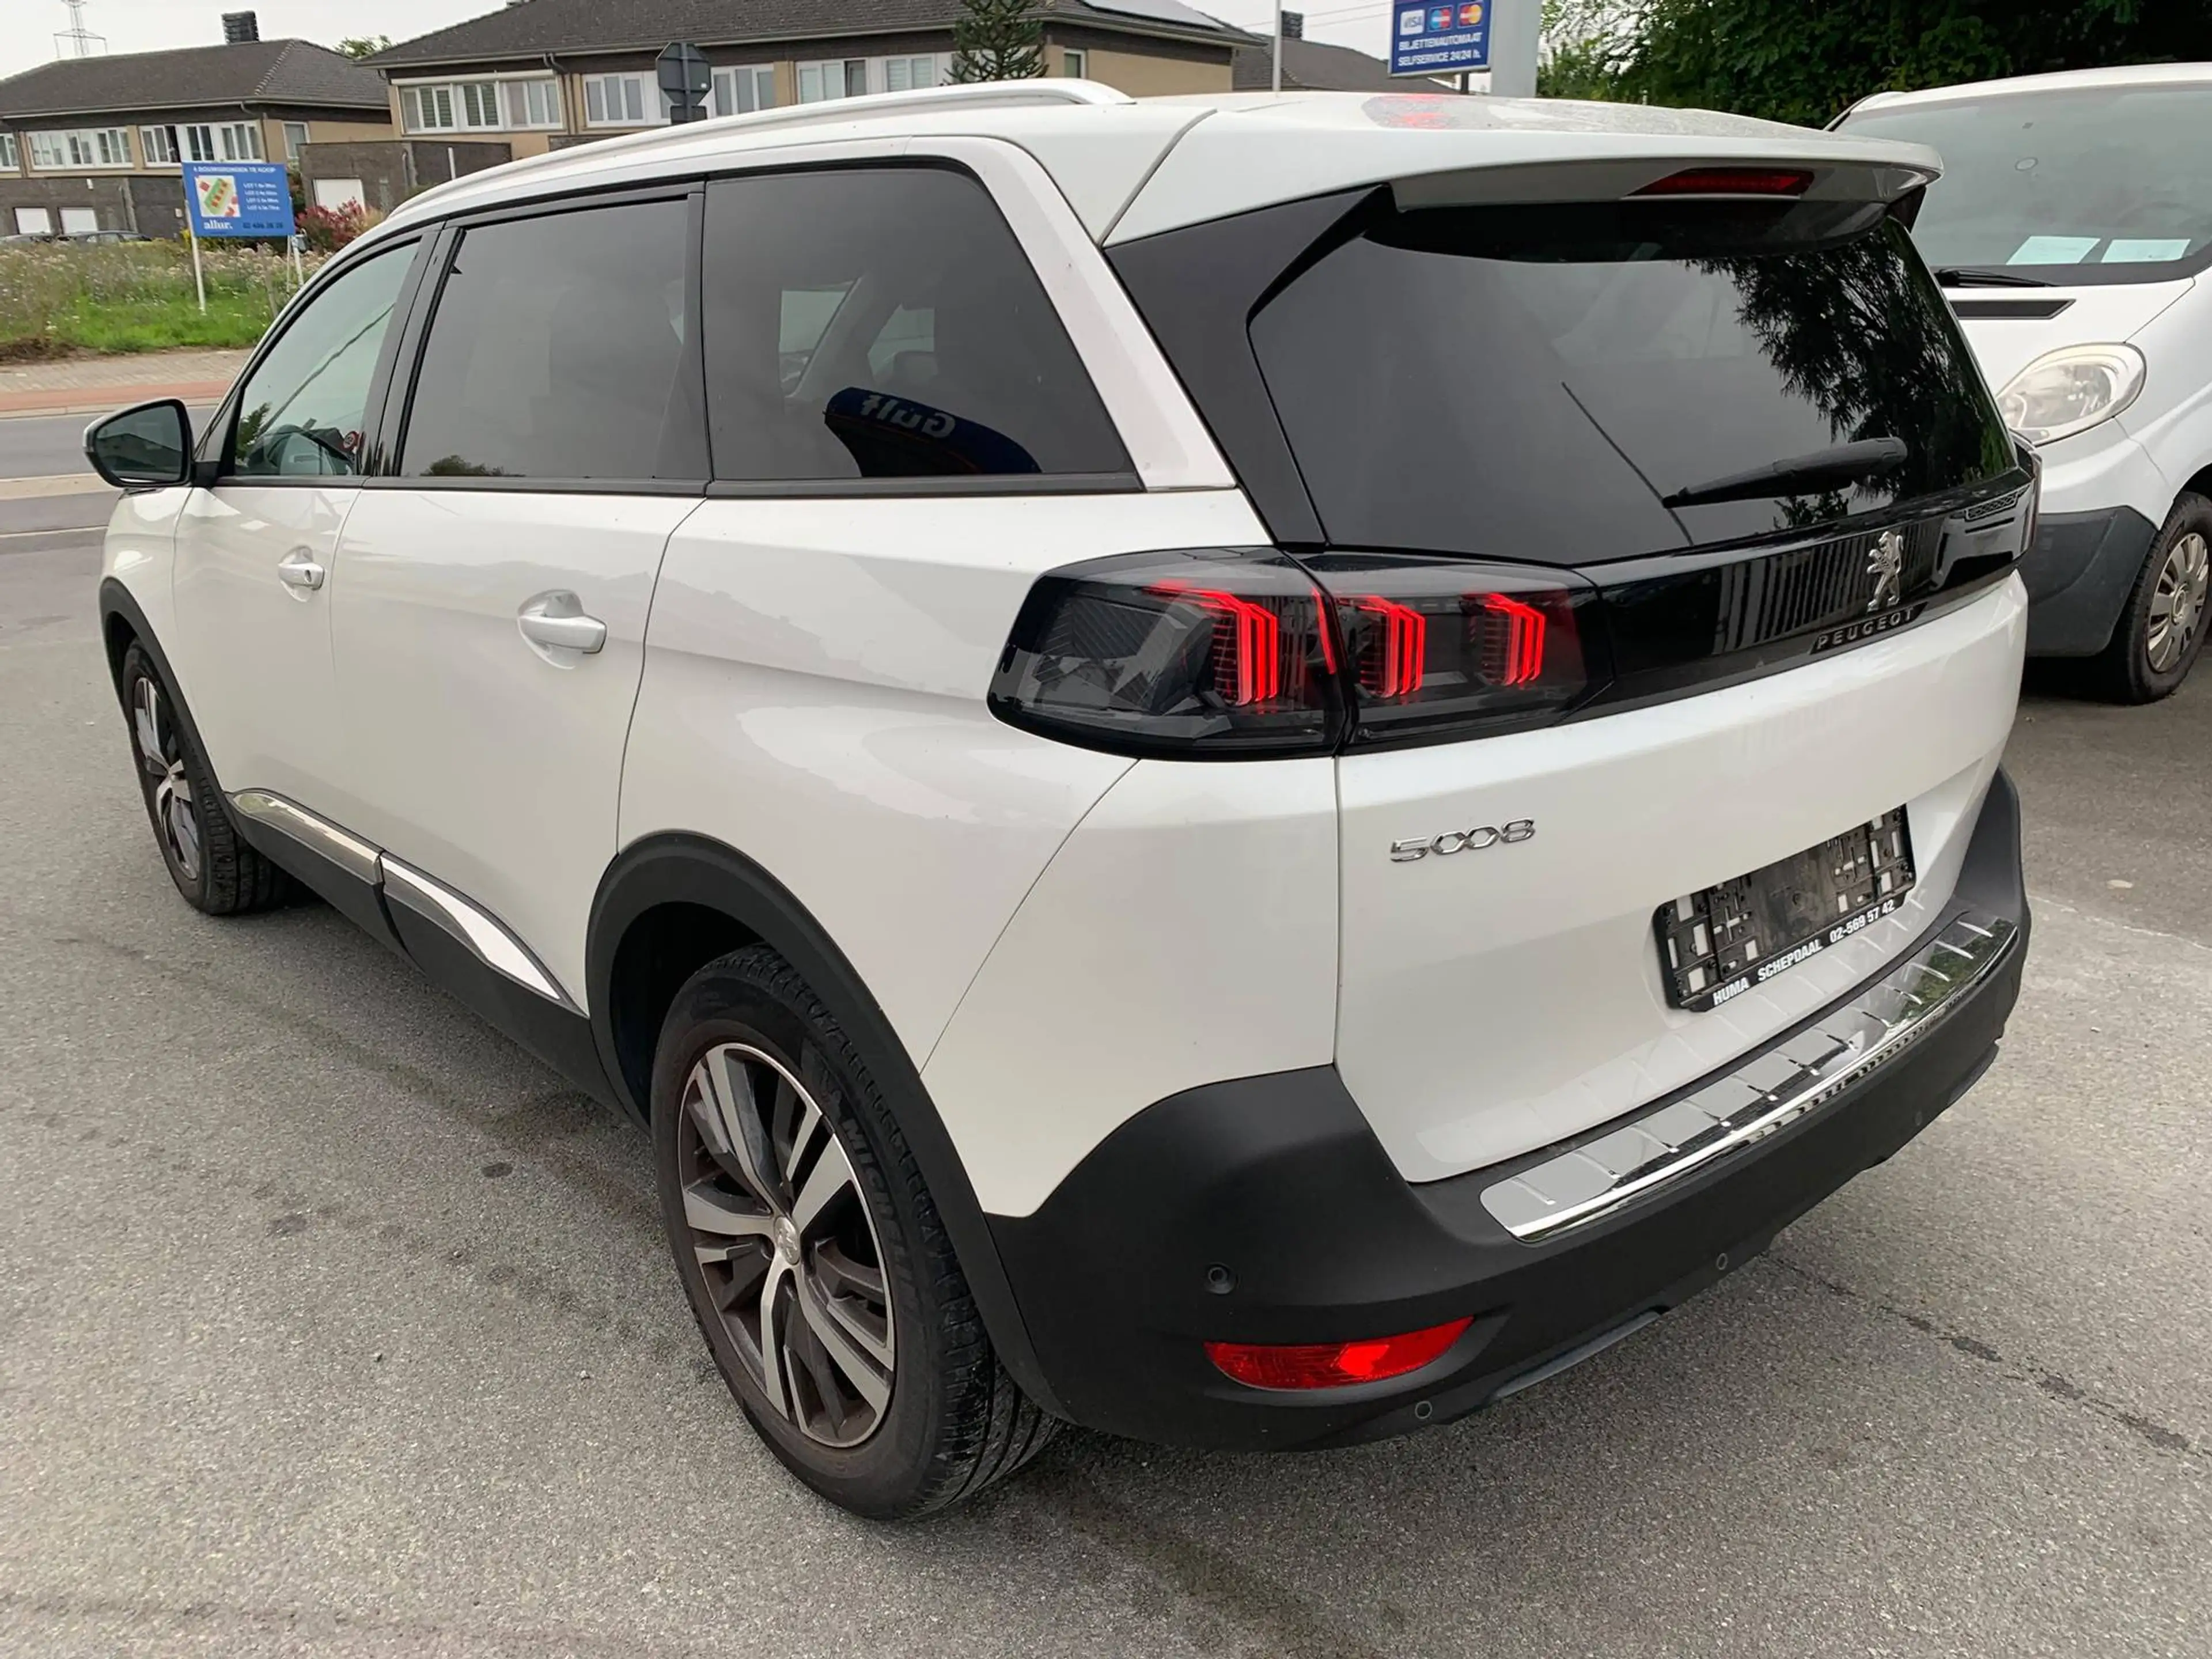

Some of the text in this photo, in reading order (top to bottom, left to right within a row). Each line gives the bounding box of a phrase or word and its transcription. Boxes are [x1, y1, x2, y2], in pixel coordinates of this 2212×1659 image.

[1403, 16, 1422, 28] VISA
[1398, 52, 1448, 66] SELFSERVICE
[1817, 607, 1915, 650] PEUGEOT
[1391, 817, 1536, 862] 5008
[1713, 899, 1895, 1006] HUMA SCHEPDAAL 02-569 57 42
